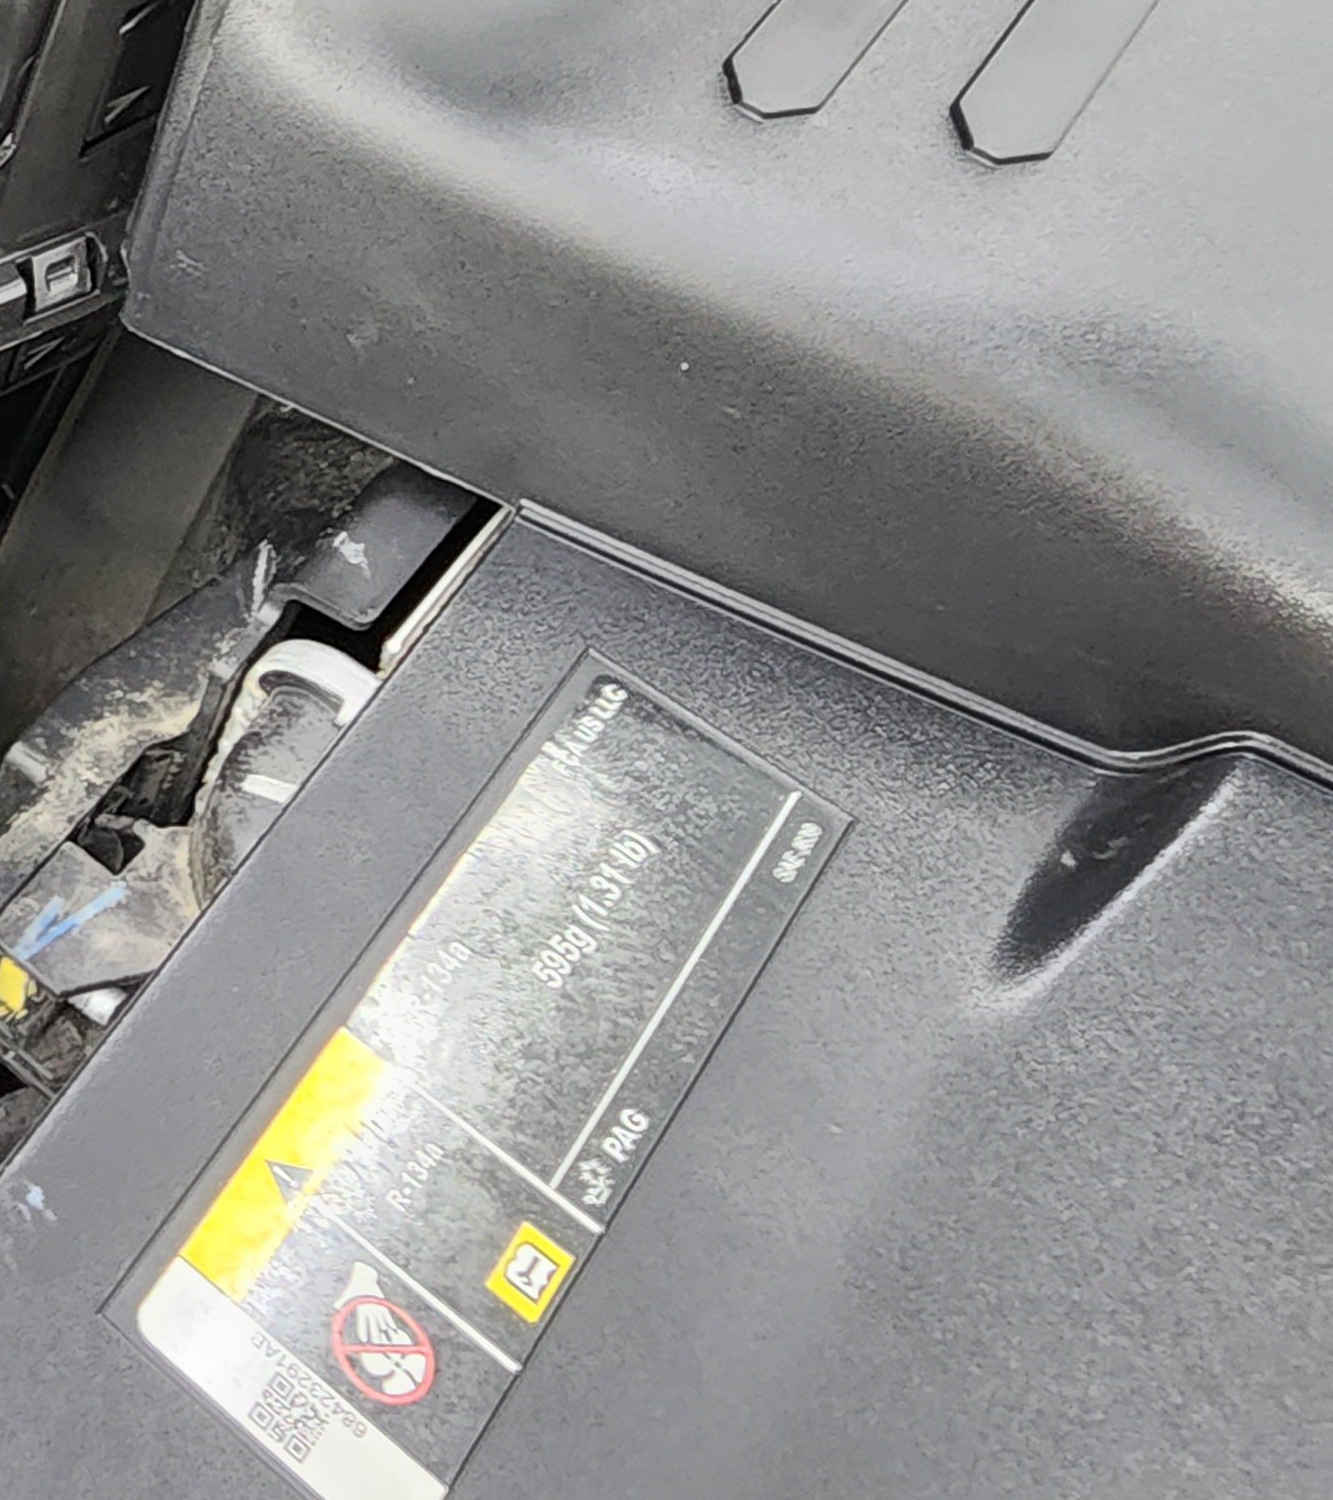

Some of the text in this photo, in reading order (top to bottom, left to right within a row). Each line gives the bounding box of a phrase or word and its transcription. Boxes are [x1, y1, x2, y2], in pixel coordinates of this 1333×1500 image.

[573, 714, 606, 743] US
[588, 683, 628, 721] LLC
[533, 829, 662, 989] 595g (1.31 lb)
[600, 1108, 649, 1163] PAG
[386, 1142, 445, 1213] R-134a
